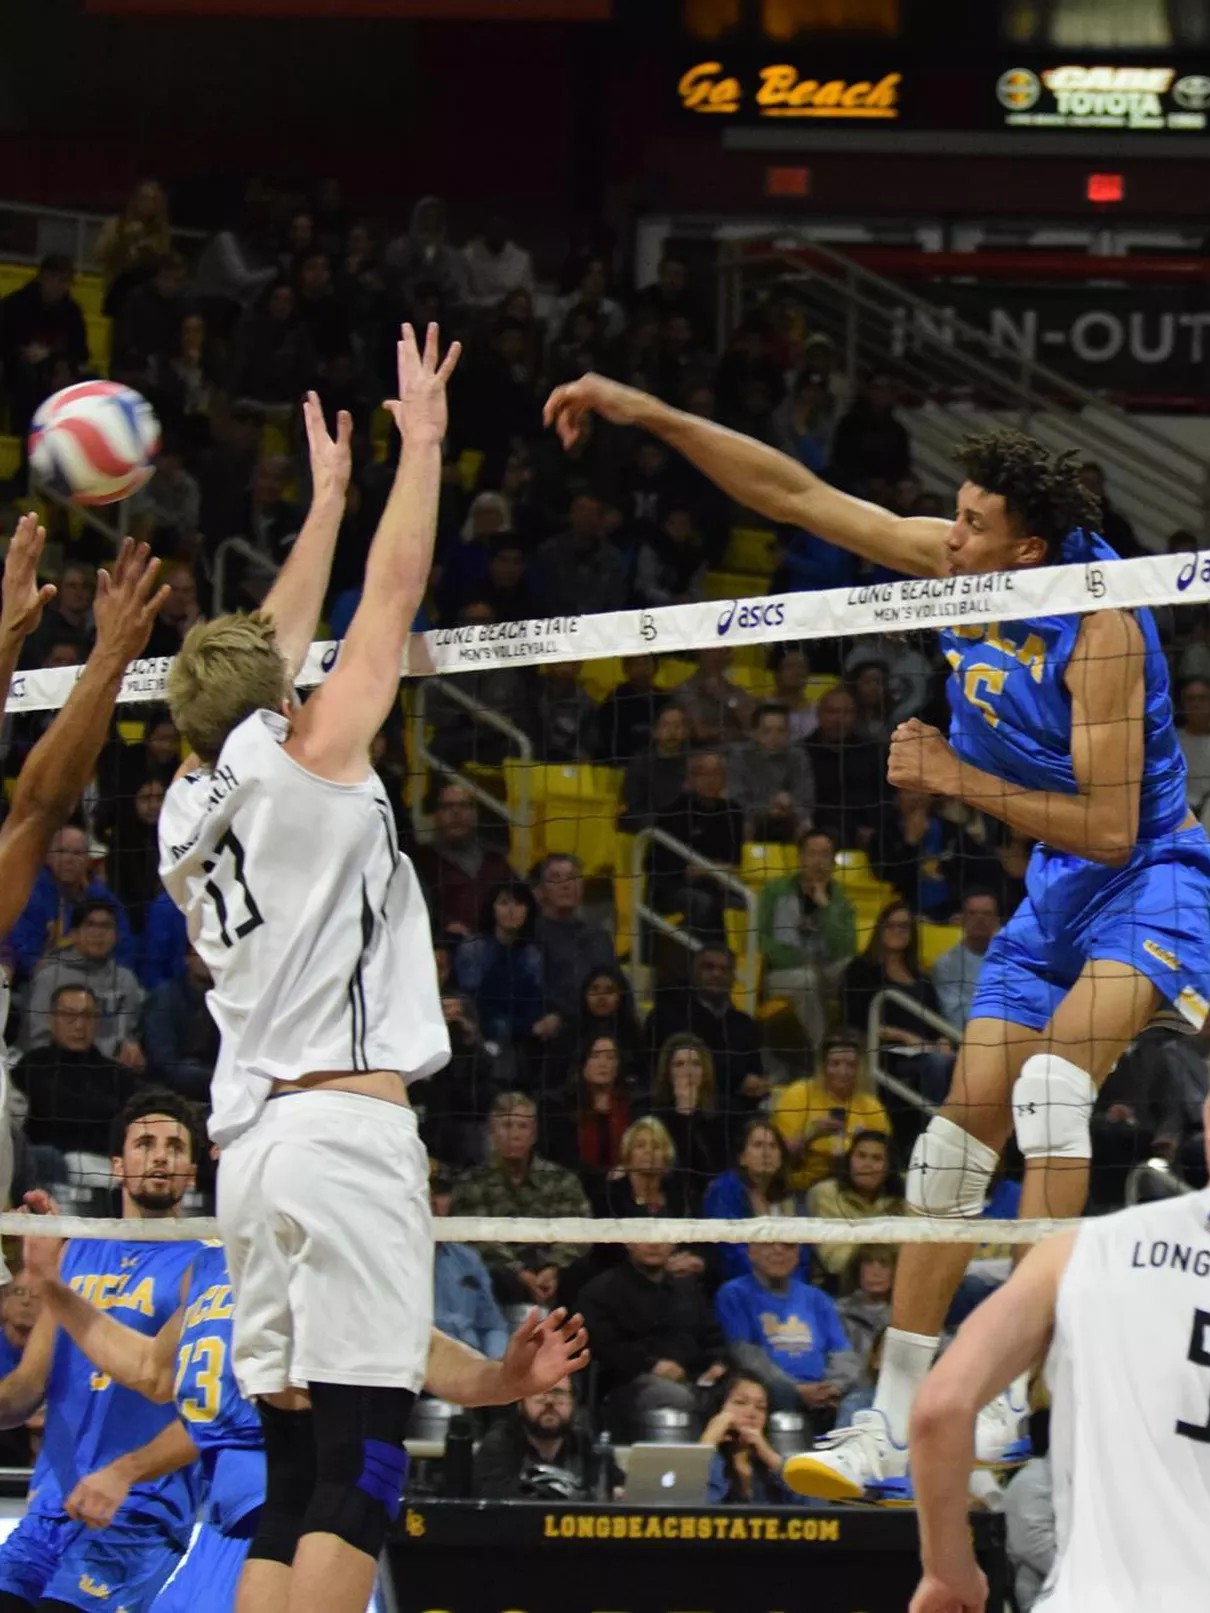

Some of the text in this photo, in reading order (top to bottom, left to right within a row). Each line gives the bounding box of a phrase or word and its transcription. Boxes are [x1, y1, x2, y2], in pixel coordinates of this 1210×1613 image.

[677, 61, 902, 117] Go Beach
[1055, 92, 1162, 116] TOYOTA
[848, 571, 1014, 605] LONG BEACH STATE
[174, 1336, 226, 1423] 13
[544, 1514, 840, 1541] LONGBEACHSTATE.COM
